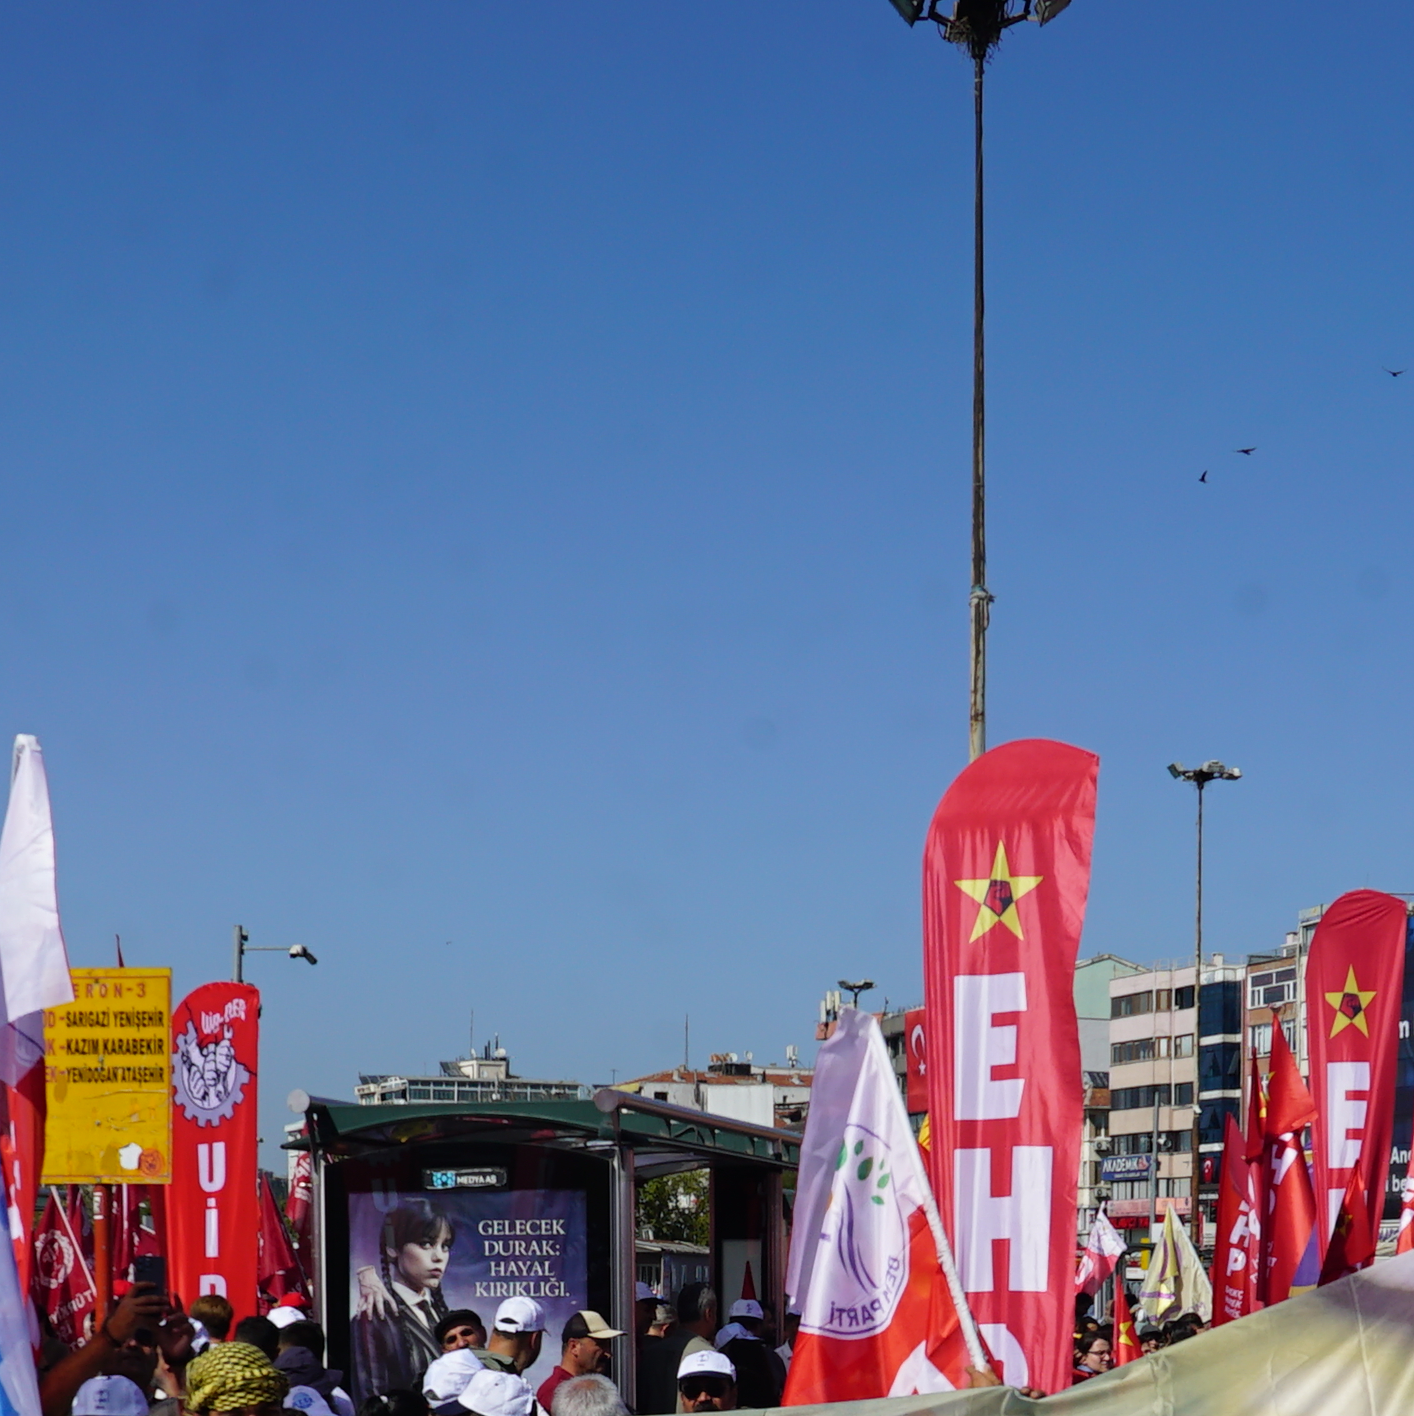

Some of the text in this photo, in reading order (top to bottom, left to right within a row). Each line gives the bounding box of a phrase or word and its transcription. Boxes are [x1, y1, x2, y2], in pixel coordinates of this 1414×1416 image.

[72, 983, 147, 999] ERON-3
[102, 1033, 165, 1056] KARABEKİR
[478, 1219, 566, 1236] GELECEK
[484, 1240, 561, 1256] DURAK:
[490, 1260, 555, 1277] HAYAL
[475, 1278, 570, 1297] KIRIKLIĞI.
